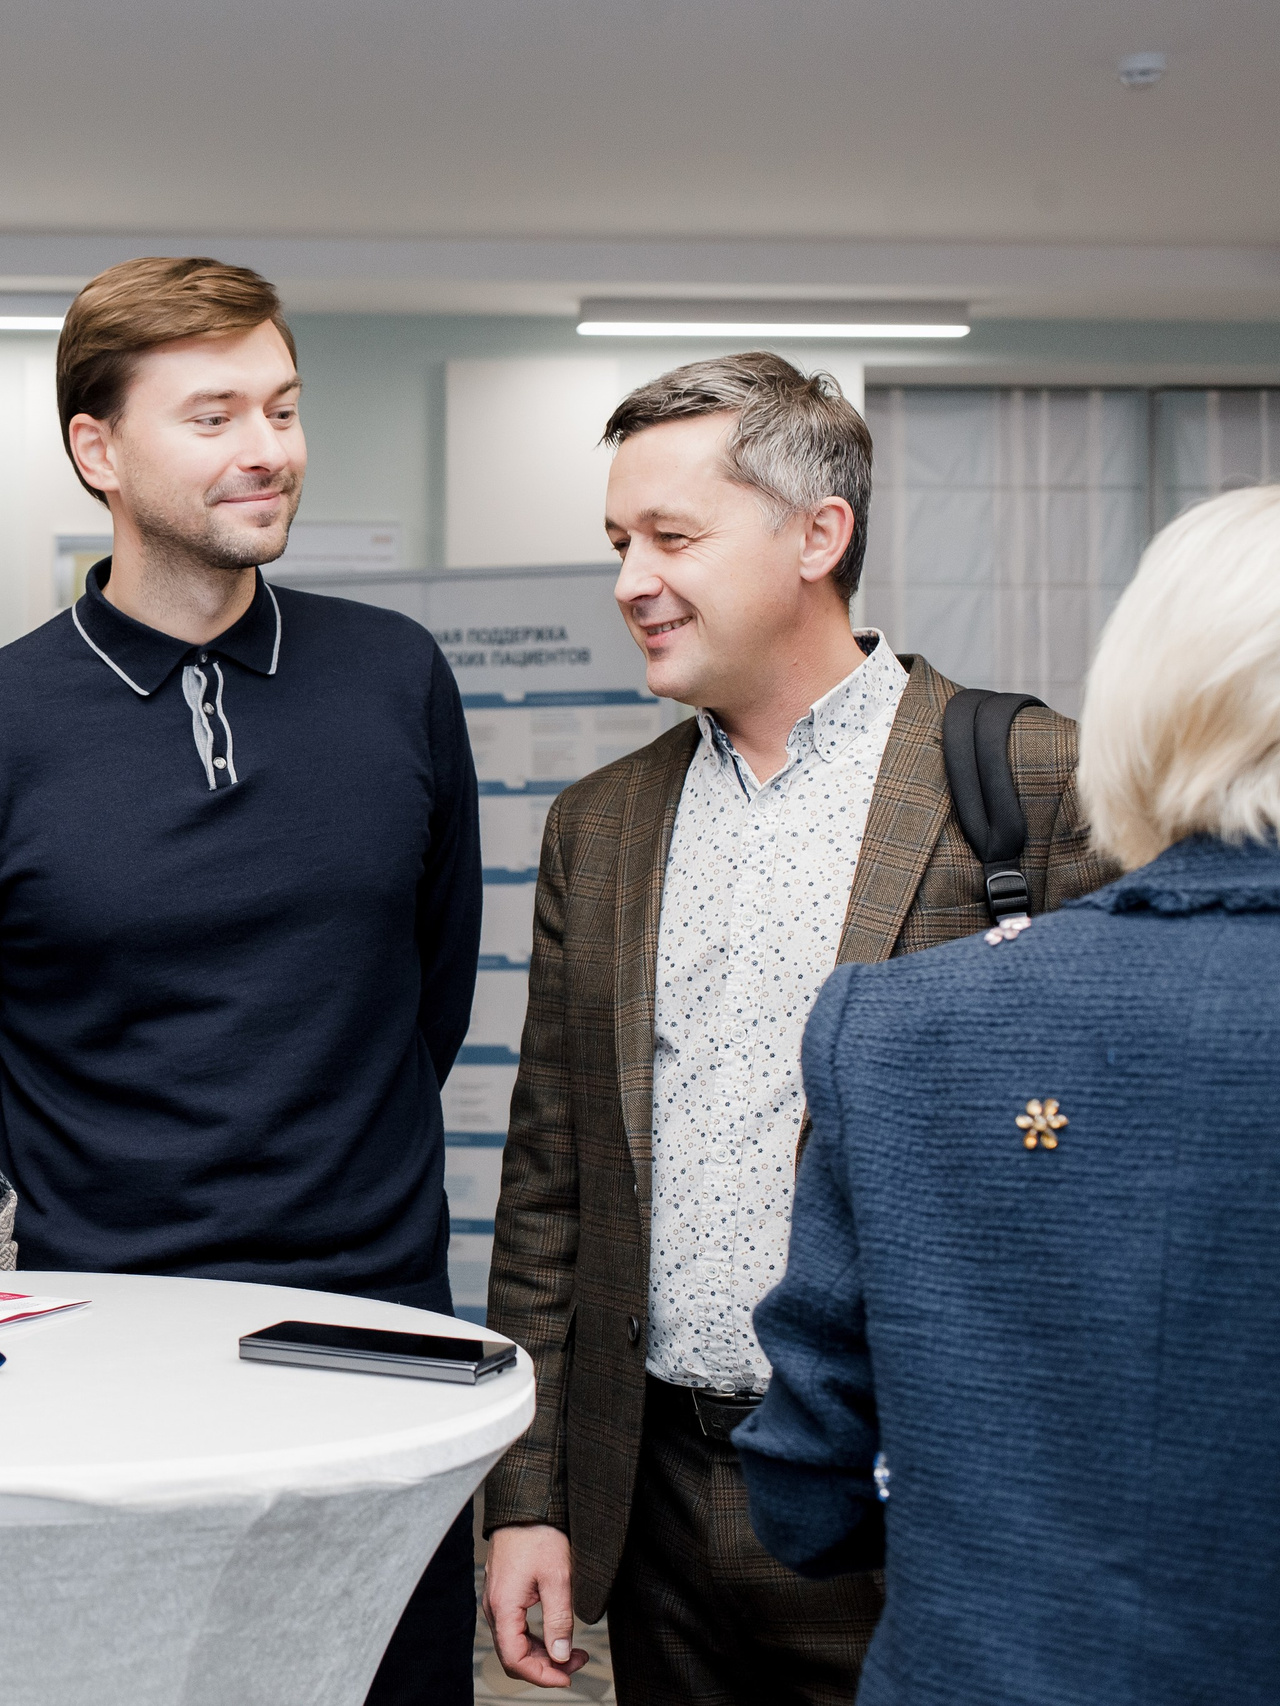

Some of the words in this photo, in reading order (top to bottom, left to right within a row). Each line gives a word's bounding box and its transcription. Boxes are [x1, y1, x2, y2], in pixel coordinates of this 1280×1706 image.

[433, 628, 462, 645] НАЯ
[467, 625, 568, 645] ПОДДЕРЖКА
[446, 650, 485, 667] СКИХ
[490, 648, 591, 667] ПАЦИЕНТОВ
